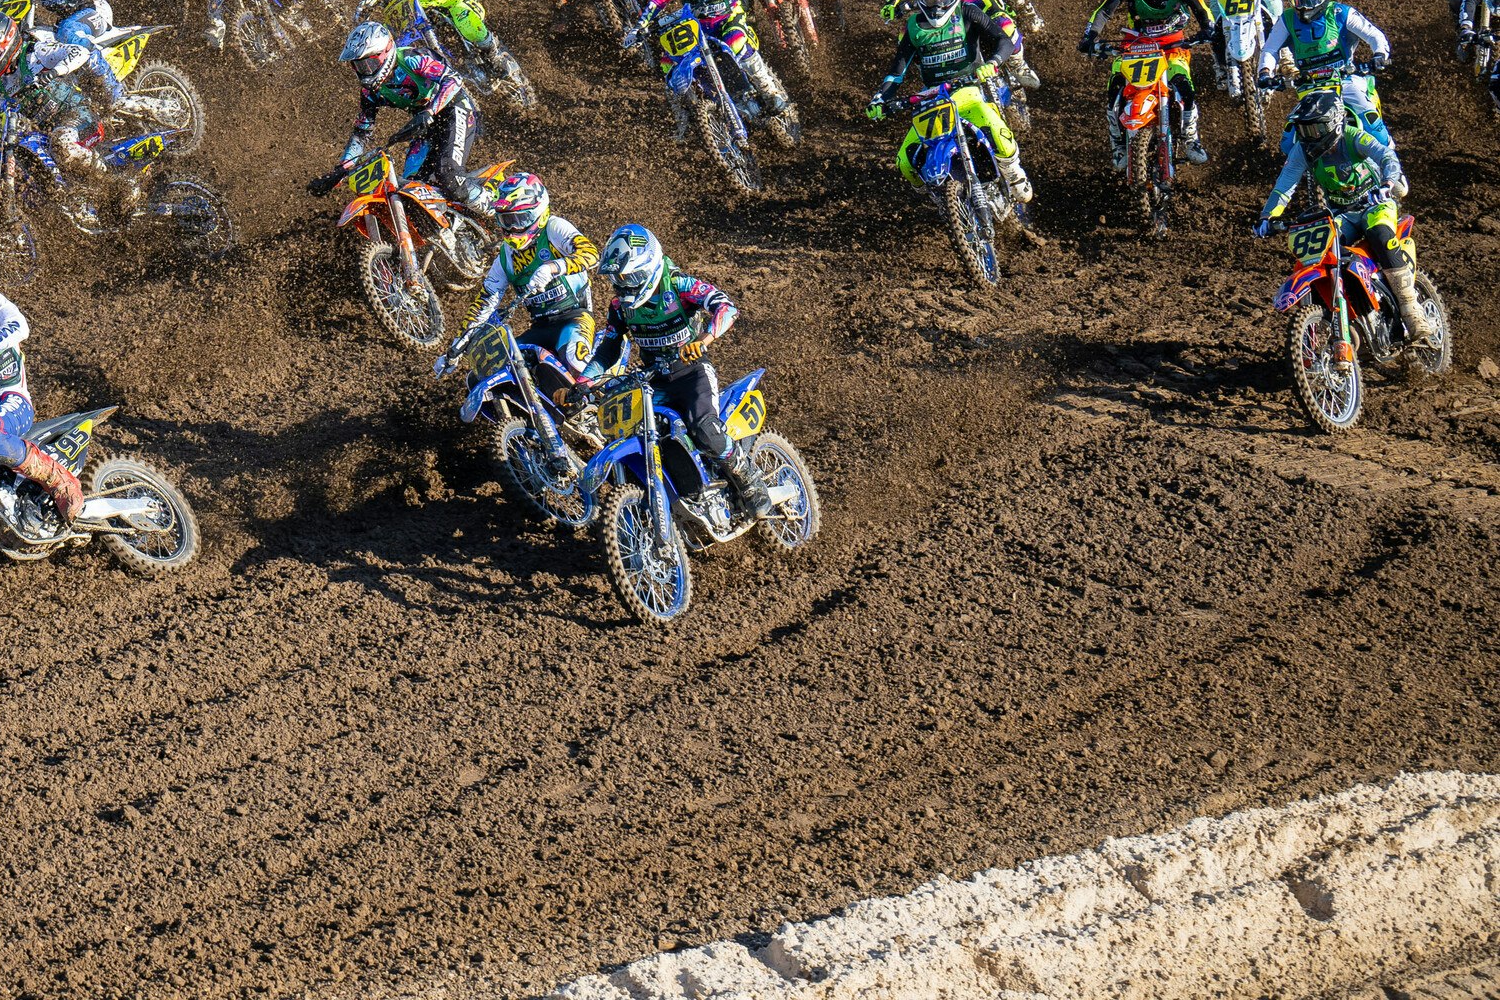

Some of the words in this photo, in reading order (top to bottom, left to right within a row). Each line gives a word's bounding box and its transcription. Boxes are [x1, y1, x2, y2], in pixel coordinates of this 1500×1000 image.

[666, 23, 696, 54] 19
[1128, 60, 1160, 83] 11
[918, 105, 953, 140] 71
[355, 162, 385, 193] 24
[1292, 226, 1330, 258] 89
[602, 395, 633, 429] 51
[739, 394, 765, 429] 51
[55, 427, 91, 459] 95
[656, 490, 667, 533] DUNLOP
